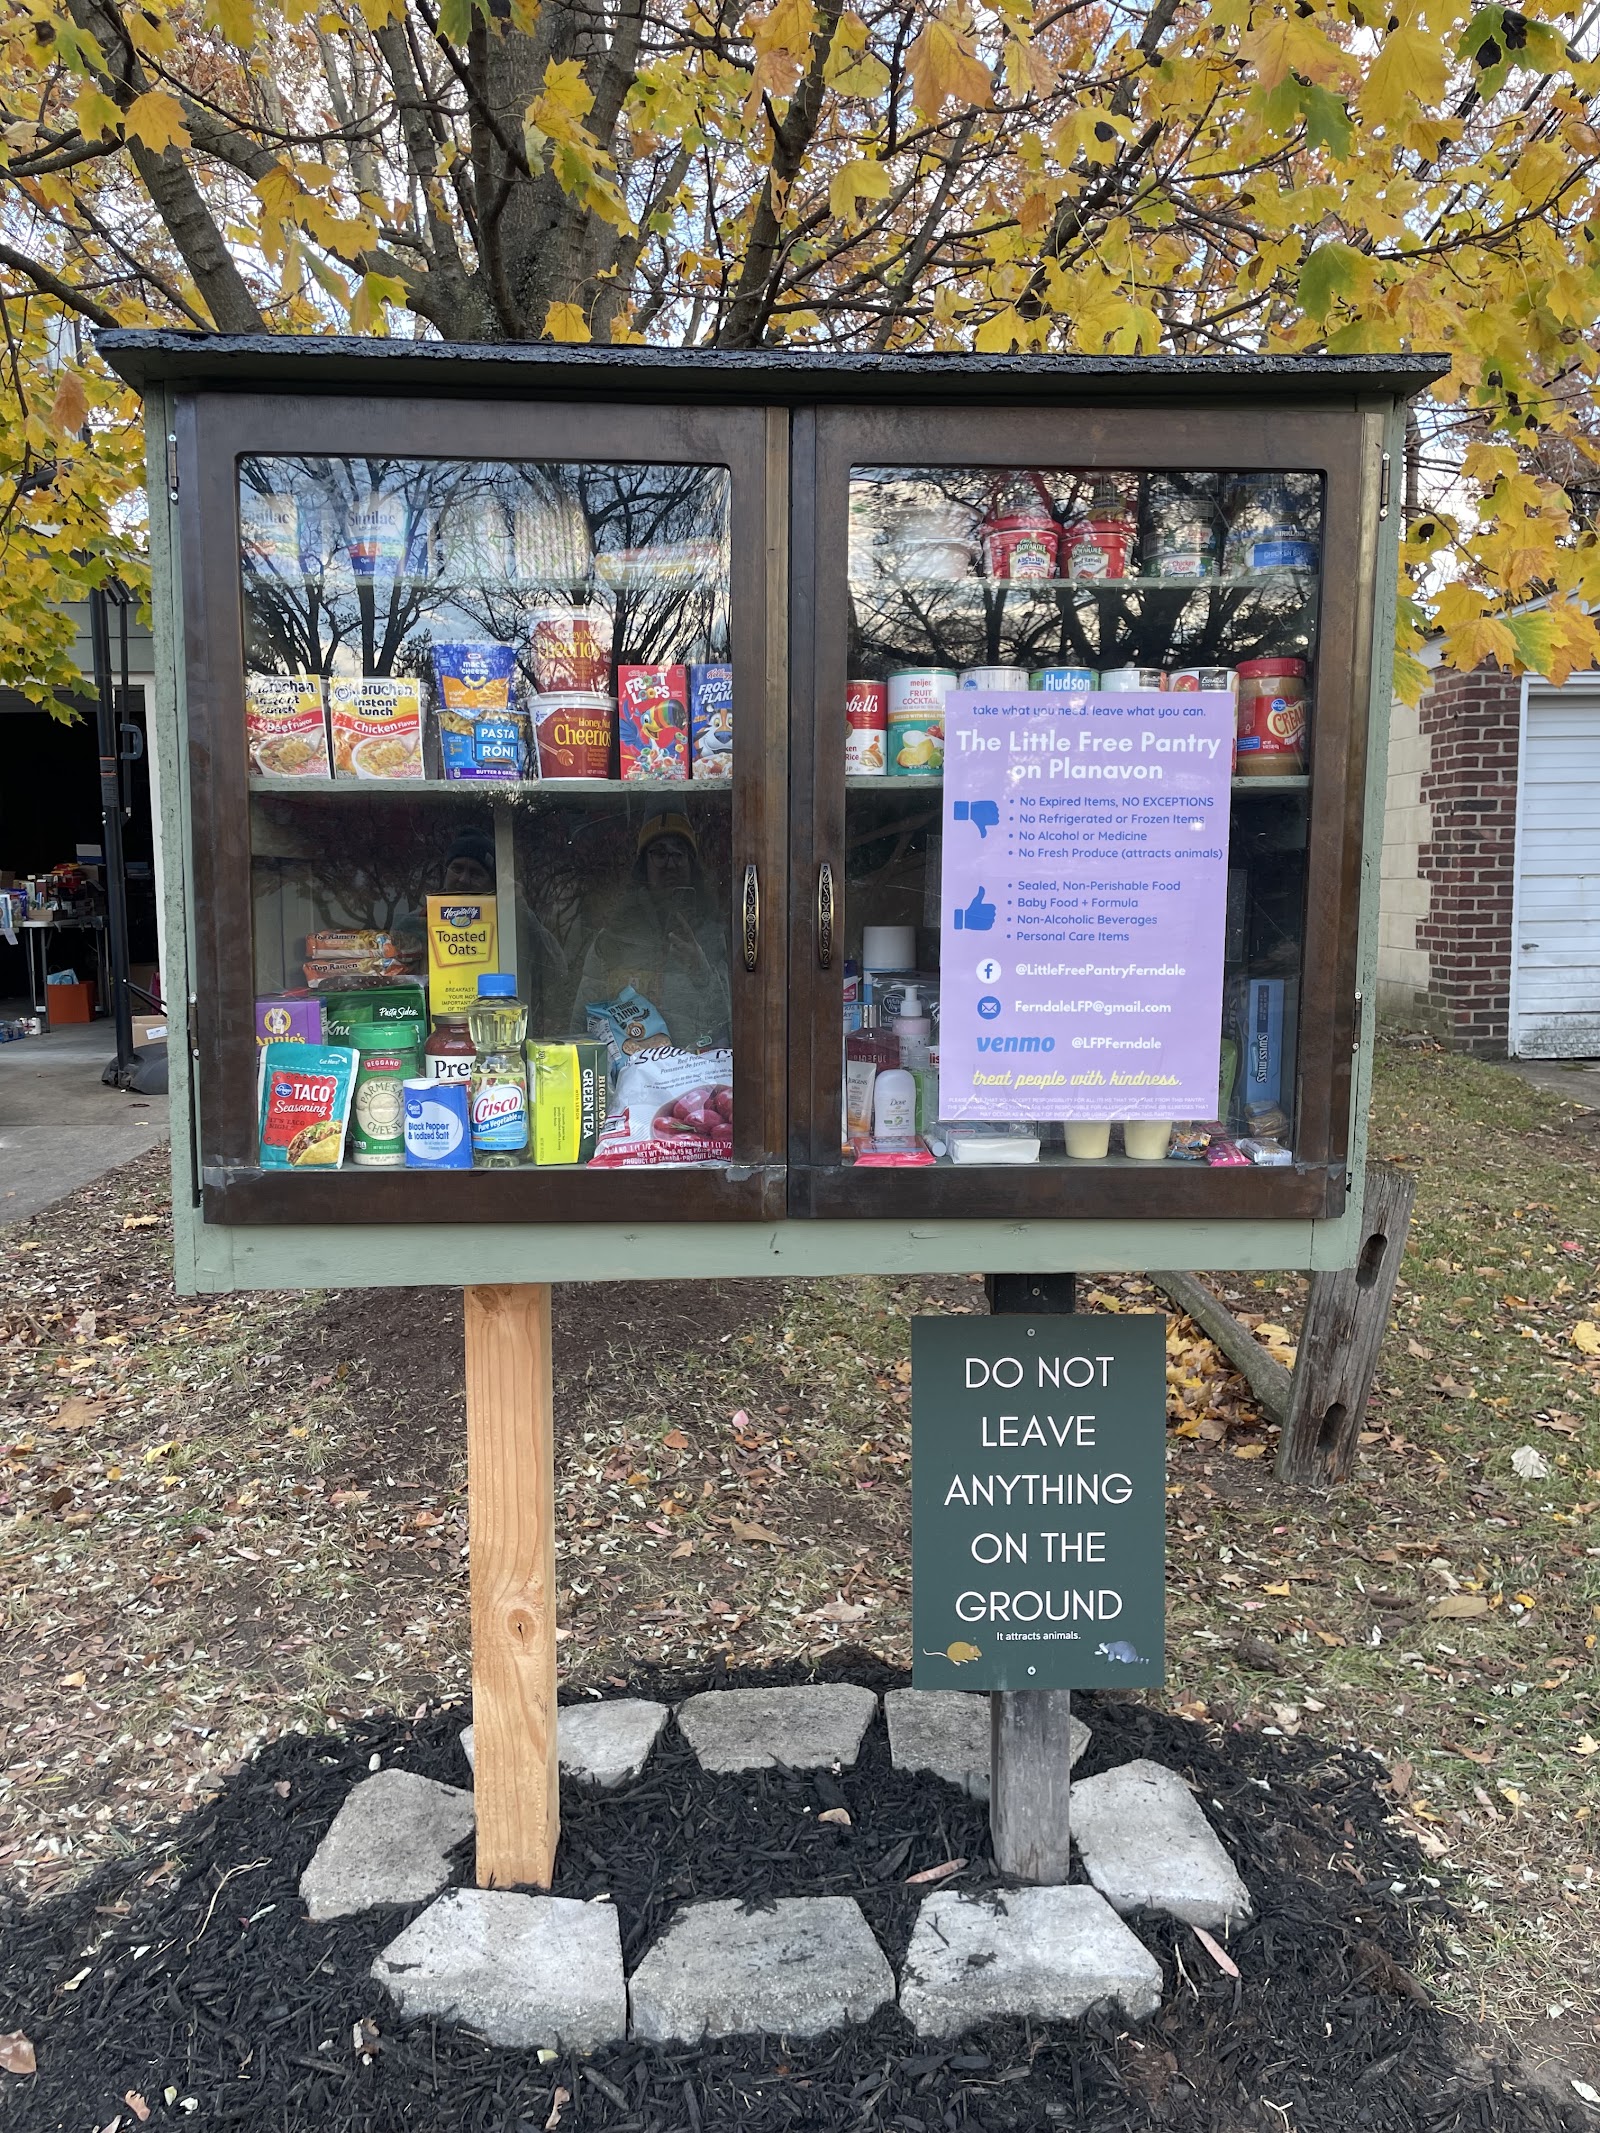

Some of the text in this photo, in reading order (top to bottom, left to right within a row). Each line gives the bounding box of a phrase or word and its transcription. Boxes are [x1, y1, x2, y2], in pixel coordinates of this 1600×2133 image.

[625, 673, 667, 694] FROOT
[1045, 674, 1090, 691] Hudson
[353, 698, 397, 707] Instant
[631, 686, 670, 704] LOOPS
[358, 707, 393, 716] Lunch
[973, 705, 1206, 718] take what you need. leave what you can.
[267, 718, 312, 733] Beef Flavor
[354, 719, 417, 734] Chicken Flavor
[578, 717, 601, 729] Honey
[481, 728, 515, 740] PASTA
[554, 724, 611, 747] Cheerios
[482, 745, 514, 758] RONI
[956, 730, 1001, 751] The
[1010, 729, 1071, 752] Little
[1079, 731, 1133, 752] Free
[1141, 732, 1221, 759] Pantry
[1013, 757, 1163, 779] on Planavon
[1020, 797, 1214, 809] No Expired Items, NO EXCEPTIONS
[1020, 814, 1205, 825] No Refrigerated or Frozen Items
[1020, 832, 1035, 841] No
[1038, 831, 1080, 841] Alcohol
[1098, 832, 1148, 841] Medicine
[1019, 848, 1223, 860] No Fresh Produce (attracts animals)
[1018, 881, 1181, 892] Sealed, Non-Perishable Food
[1018, 898, 1047, 910] Baby
[1050, 898, 1079, 908] Food
[1091, 898, 1139, 908] Formula
[1017, 915, 1158, 927] Non-Alcoholic Beverages
[436, 931, 486, 942] Toasted
[1017, 931, 1129, 941] Personal Care Items
[448, 944, 477, 955] Oats
[1016, 963, 1186, 979] @LittleFreePantryFerndale
[379, 1007, 397, 1017] Pasta
[612, 1006, 640, 1023] FARRO
[1015, 1000, 1171, 1016] FerndaleLFP@gmail.com
[632, 1027, 640, 1036] 10
[256, 1033, 305, 1046] Annie's
[976, 1036, 1162, 1052] venmo @LFPFerndale
[972, 1070, 1182, 1090] treat people with kindness.
[294, 1084, 330, 1102] TACO
[274, 1101, 327, 1117] Seasoning
[475, 1097, 517, 1123] Crisco
[582, 1069, 593, 1139] GREEN TEA
[367, 1120, 402, 1134] CHEESE
[409, 1122, 449, 1133] Black Pepper
[478, 1113, 517, 1132] Pure Vegetable
[965, 1356, 1114, 1389] DO NOT
[982, 1414, 1096, 1447] LEAVE
[943, 1473, 1133, 1506] ANYTHING
[971, 1532, 1106, 1564] ON THE
[955, 1589, 1123, 1622] GROUND
[996, 1631, 1081, 1641] It attracts animals.
